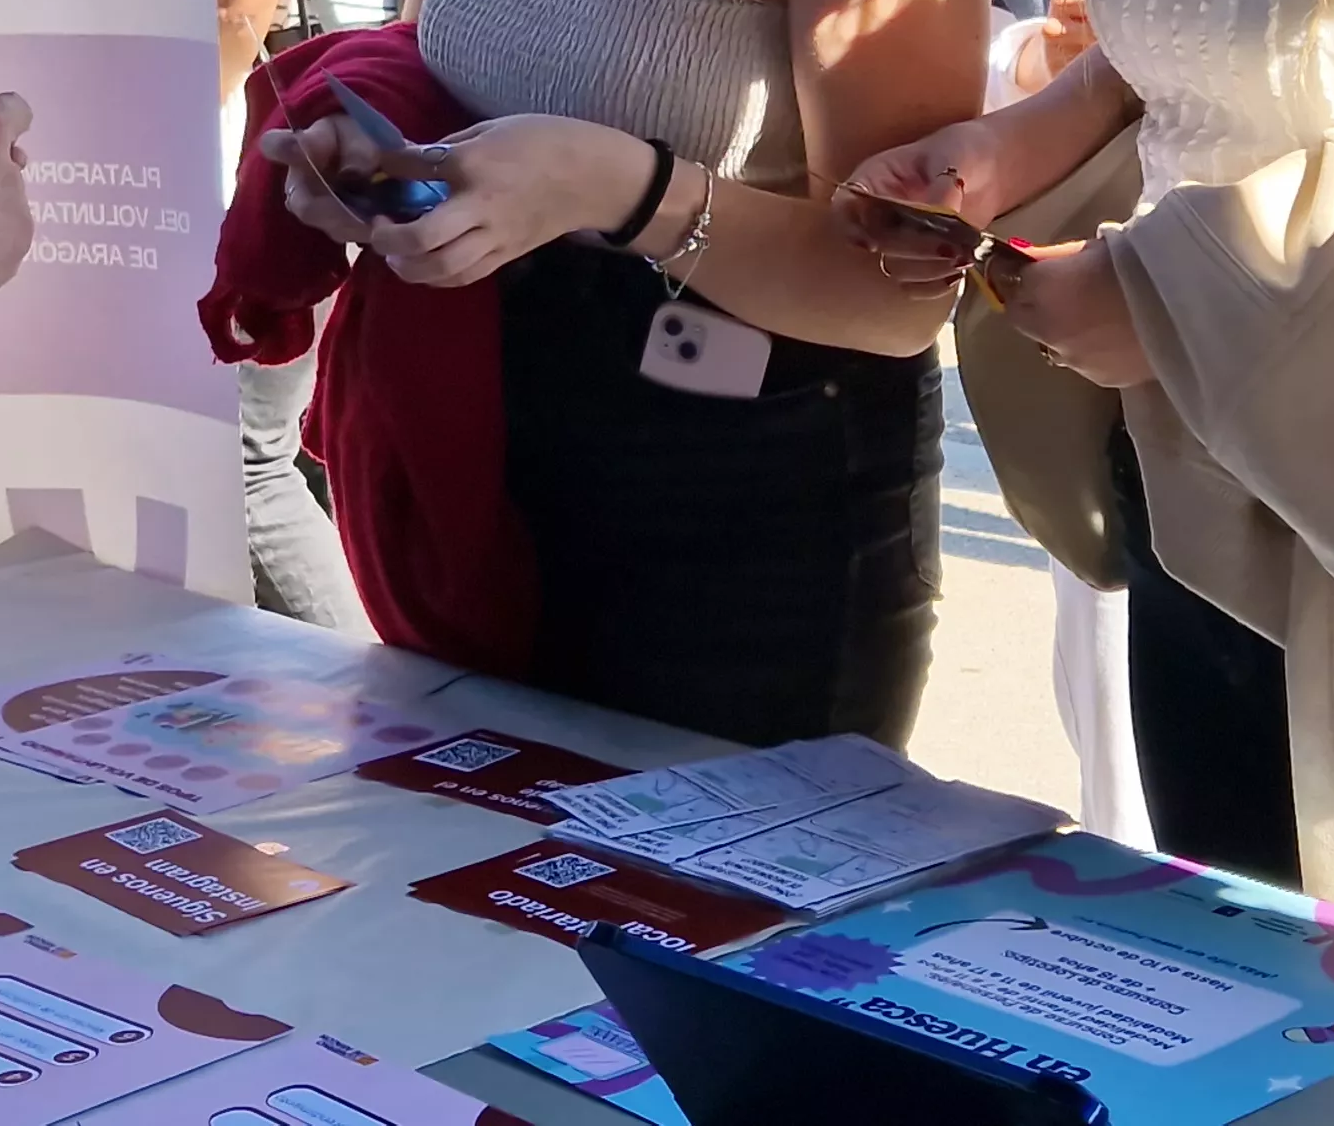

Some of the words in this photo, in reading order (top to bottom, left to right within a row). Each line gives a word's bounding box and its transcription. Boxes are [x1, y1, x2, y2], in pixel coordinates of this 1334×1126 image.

[131, 776, 160, 787] DE
[433, 781, 459, 789] el
[459, 785, 488, 796] en
[486, 793, 545, 812] enos
[79, 858, 117, 875] en
[144, 858, 267, 912] Instagram
[112, 872, 228, 924] Síguenos
[487, 889, 588, 937] tariado
[1050, 929, 1116, 954] octubre
[931, 951, 972, 968] años
[1116, 949, 1140, 961] de
[1139, 958, 1161, 969] 10
[968, 966, 990, 976] 17
[1057, 956, 1100, 974] años
[1159, 964, 1181, 973] el
[1077, 973, 1103, 987] de
[1101, 971, 1119, 981] 18
[1119, 977, 1144, 989] de
[1181, 971, 1235, 993] Hasta
[997, 987, 1020, 996] de
[1017, 981, 1042, 991] de
[1017, 994, 1081, 1018] infantil
[1039, 989, 1104, 1013] juvenil
[1101, 981, 1191, 1016] Concurso
[1018, 1003, 1043, 1016] de
[1044, 1013, 1129, 1046] Concurso
[1079, 1014, 1177, 1050] Modalidad
[1097, 1008, 1195, 1044] Modalidad
